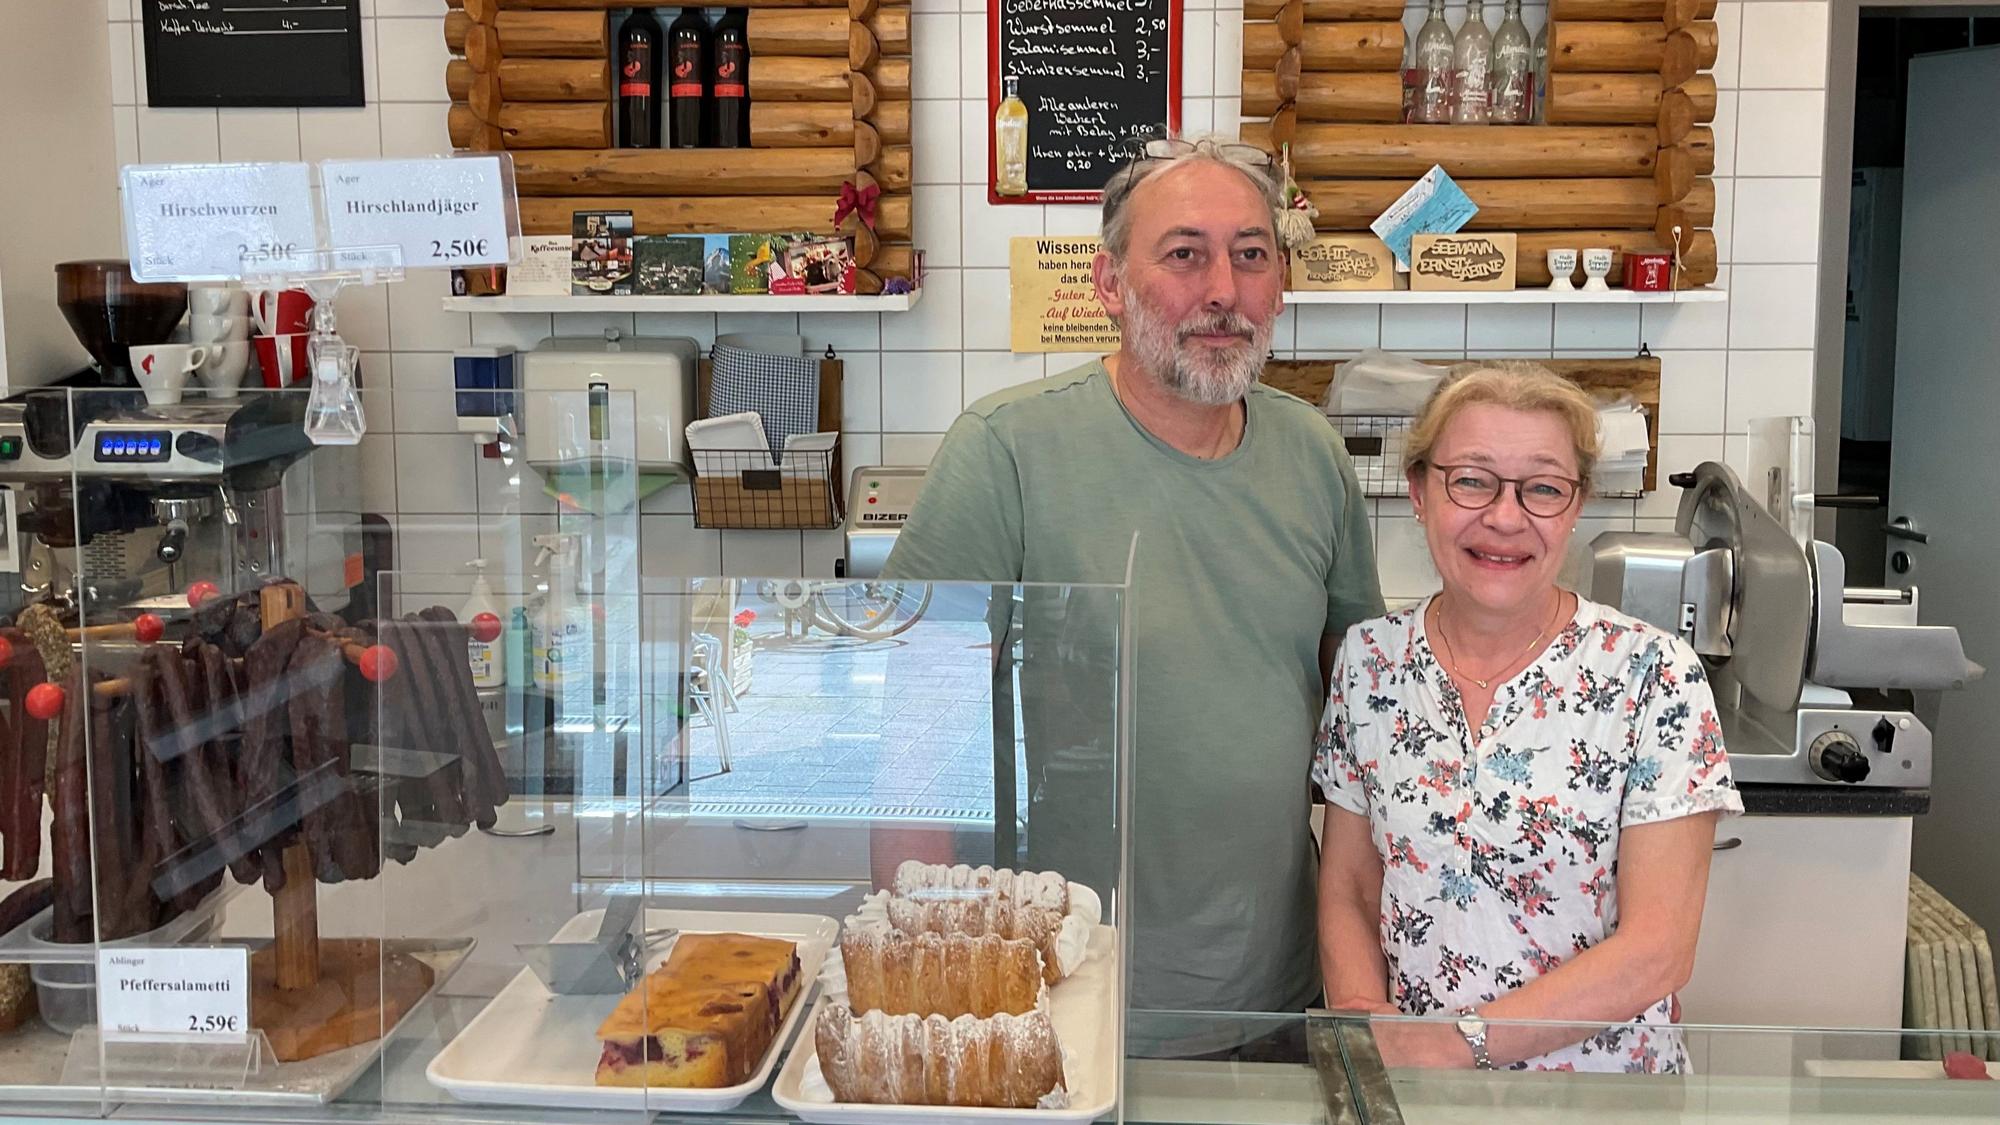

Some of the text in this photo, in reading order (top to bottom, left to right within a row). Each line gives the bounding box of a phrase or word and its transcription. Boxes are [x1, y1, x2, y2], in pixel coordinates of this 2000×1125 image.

[1007, 15, 1166, 37] Wurstsemmel 2,50
[1008, 38, 1117, 56] Salamisemmel
[1008, 60, 1125, 79] Schinkensemmel
[1049, 124, 1072, 136] mit
[1078, 125, 1115, 141] Belag
[1066, 160, 1092, 172] 0,20
[160, 203, 278, 217] Hirschwurzen
[346, 200, 480, 216] Hirschlandjäger
[238, 243, 298, 265] 2,50€
[431, 239, 489, 259] 2,50€
[1432, 241, 1494, 255] SEEMANN
[340, 252, 367, 262] Stück
[1039, 259, 1067, 270] haben
[1061, 274, 1077, 284] das
[1043, 323, 1064, 332] keine
[1066, 323, 1108, 332] bleibenden
[1041, 335, 1052, 343] bei
[1055, 335, 1094, 343] Menschen
[109, 957, 145, 966] Ablinger
[120, 978, 230, 992] Pfeffersalametti
[117, 1023, 140, 1032] Stück
[188, 1015, 238, 1034] 2,59€
